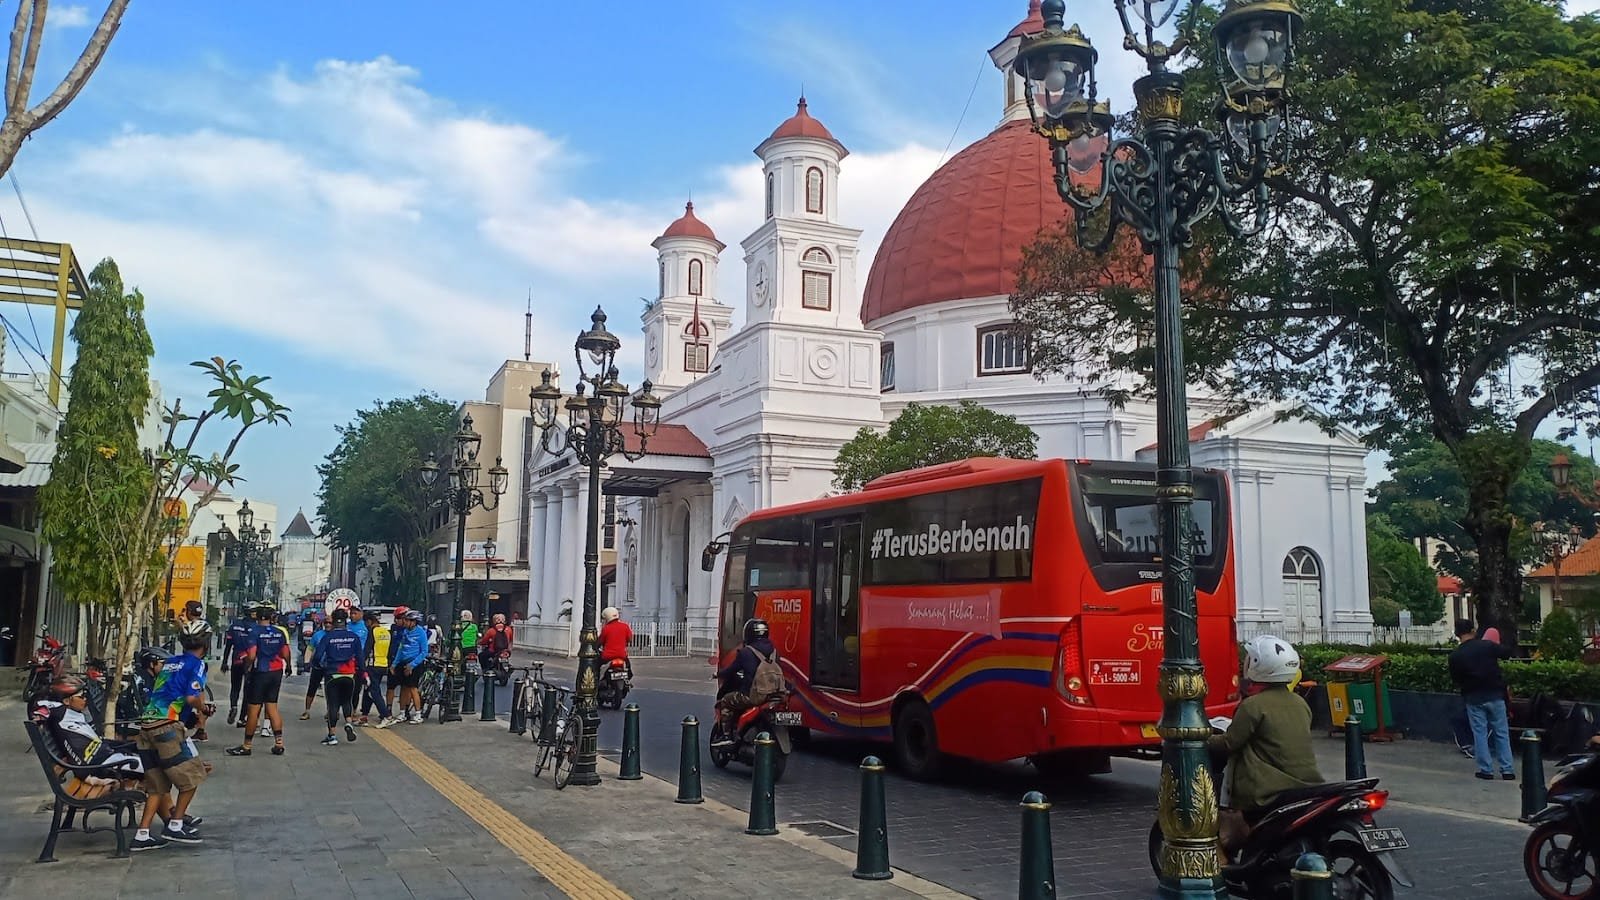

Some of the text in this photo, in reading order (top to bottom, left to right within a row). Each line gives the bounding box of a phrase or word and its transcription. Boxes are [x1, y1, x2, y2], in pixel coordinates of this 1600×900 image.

[870, 514, 1030, 559] #TerusBerbenah
[772, 598, 802, 613] TRANS
[907, 601, 946, 626] Semarang
[949, 602, 974, 619] Hebat
